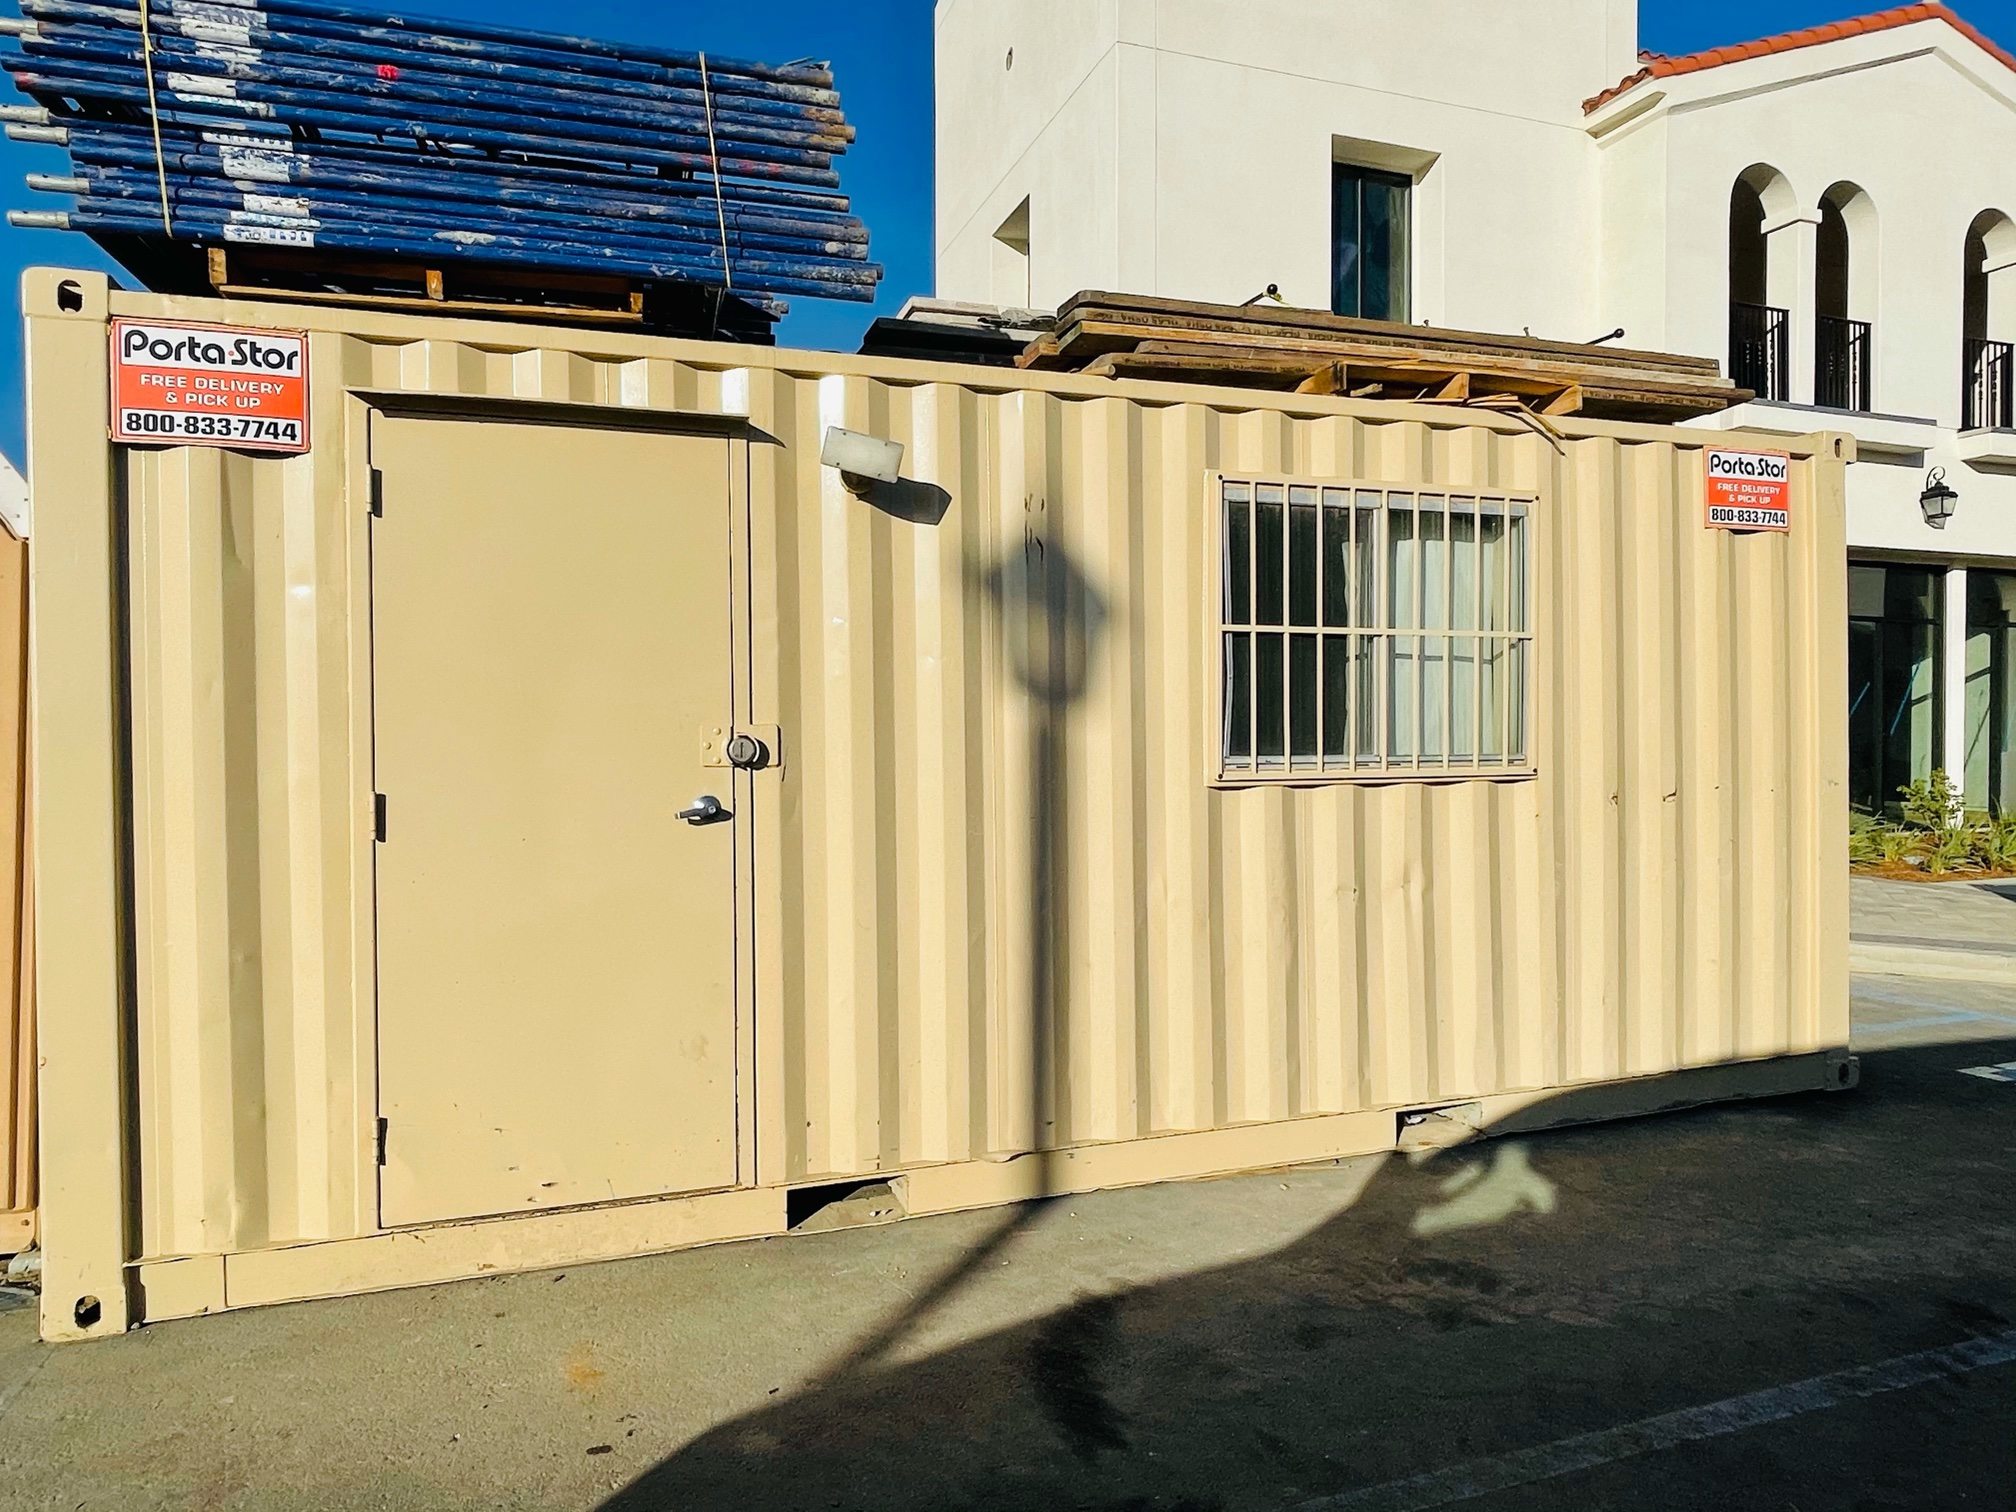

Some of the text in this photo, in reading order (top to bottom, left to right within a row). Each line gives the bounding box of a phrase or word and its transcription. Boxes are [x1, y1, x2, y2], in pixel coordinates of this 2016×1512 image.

[139, 373, 285, 395] FREE DELIVERY
[165, 391, 261, 409] & PICK UP
[126, 412, 298, 441] 800-833-7744
[1717, 482, 1781, 495] FREE DELIVERY
[1728, 494, 1771, 504] & PICK UP
[1711, 508, 1786, 525] 800-833-7744
